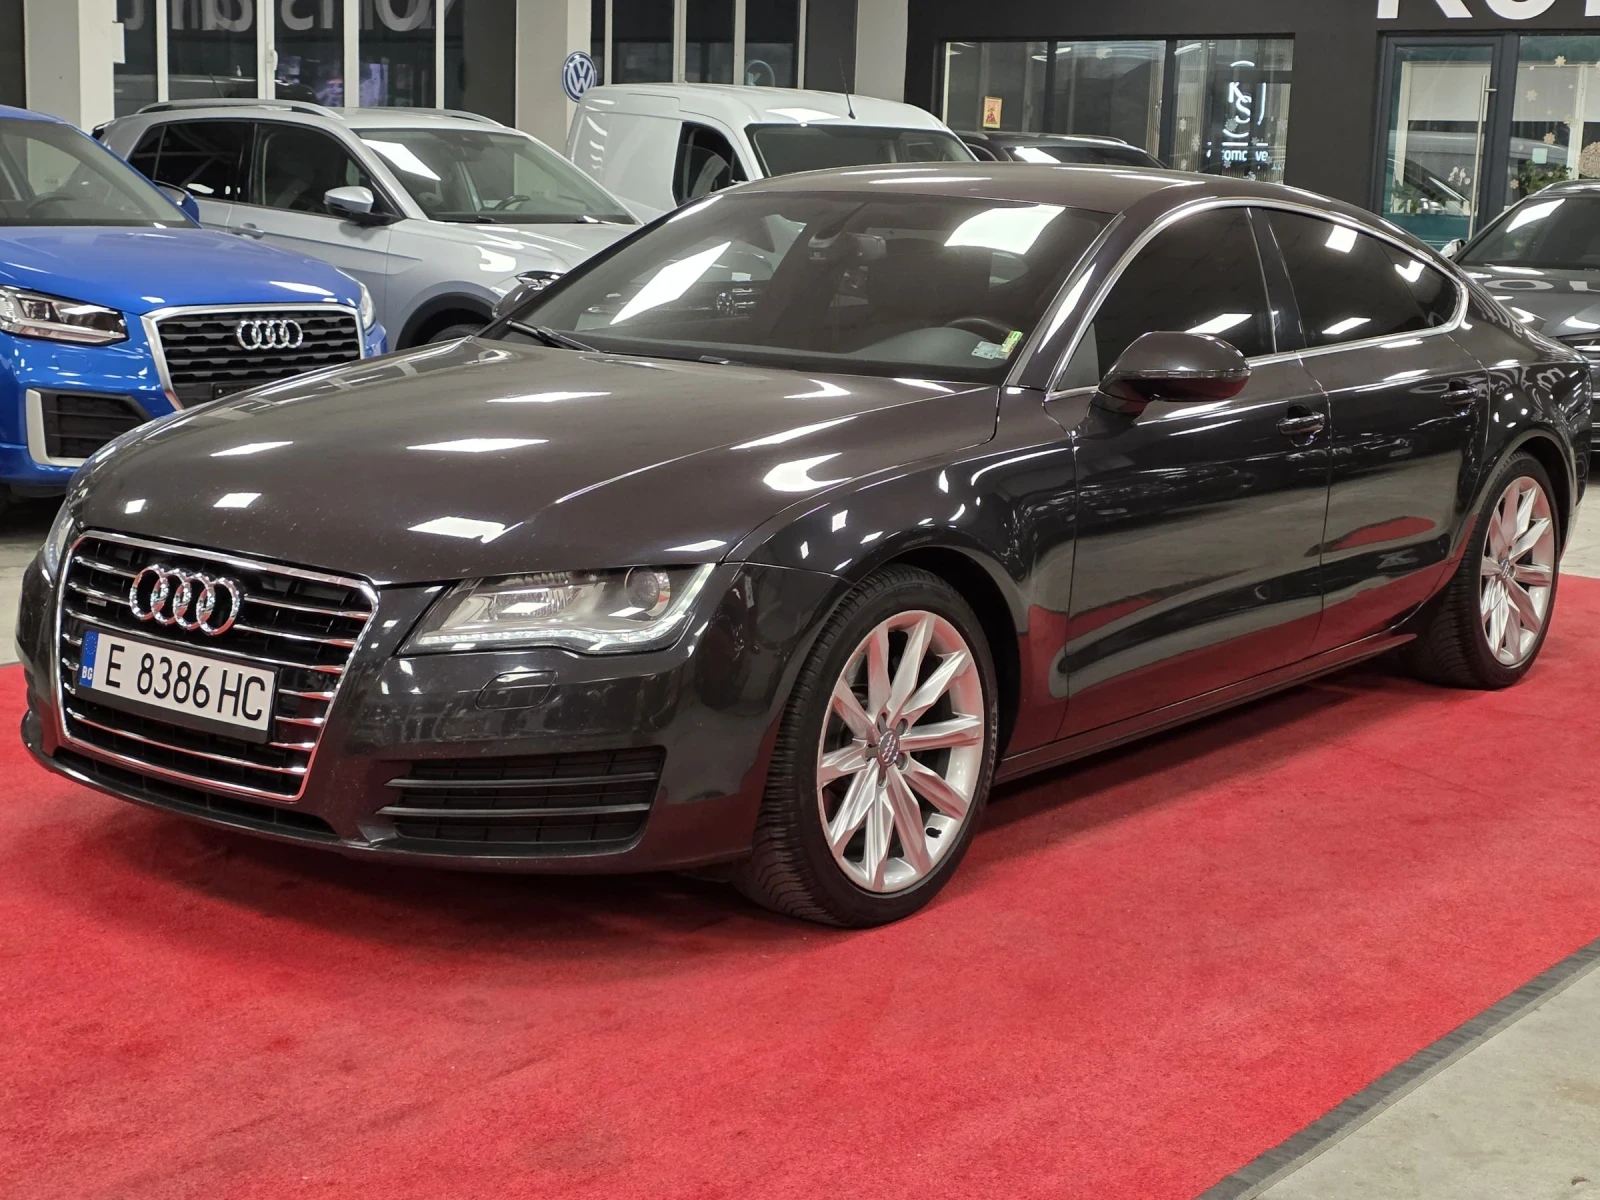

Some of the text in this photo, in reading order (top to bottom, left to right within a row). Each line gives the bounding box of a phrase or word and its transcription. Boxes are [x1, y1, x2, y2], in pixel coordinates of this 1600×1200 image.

[81, 665, 94, 680] BG
[105, 643, 266, 722] E 8386 HC
